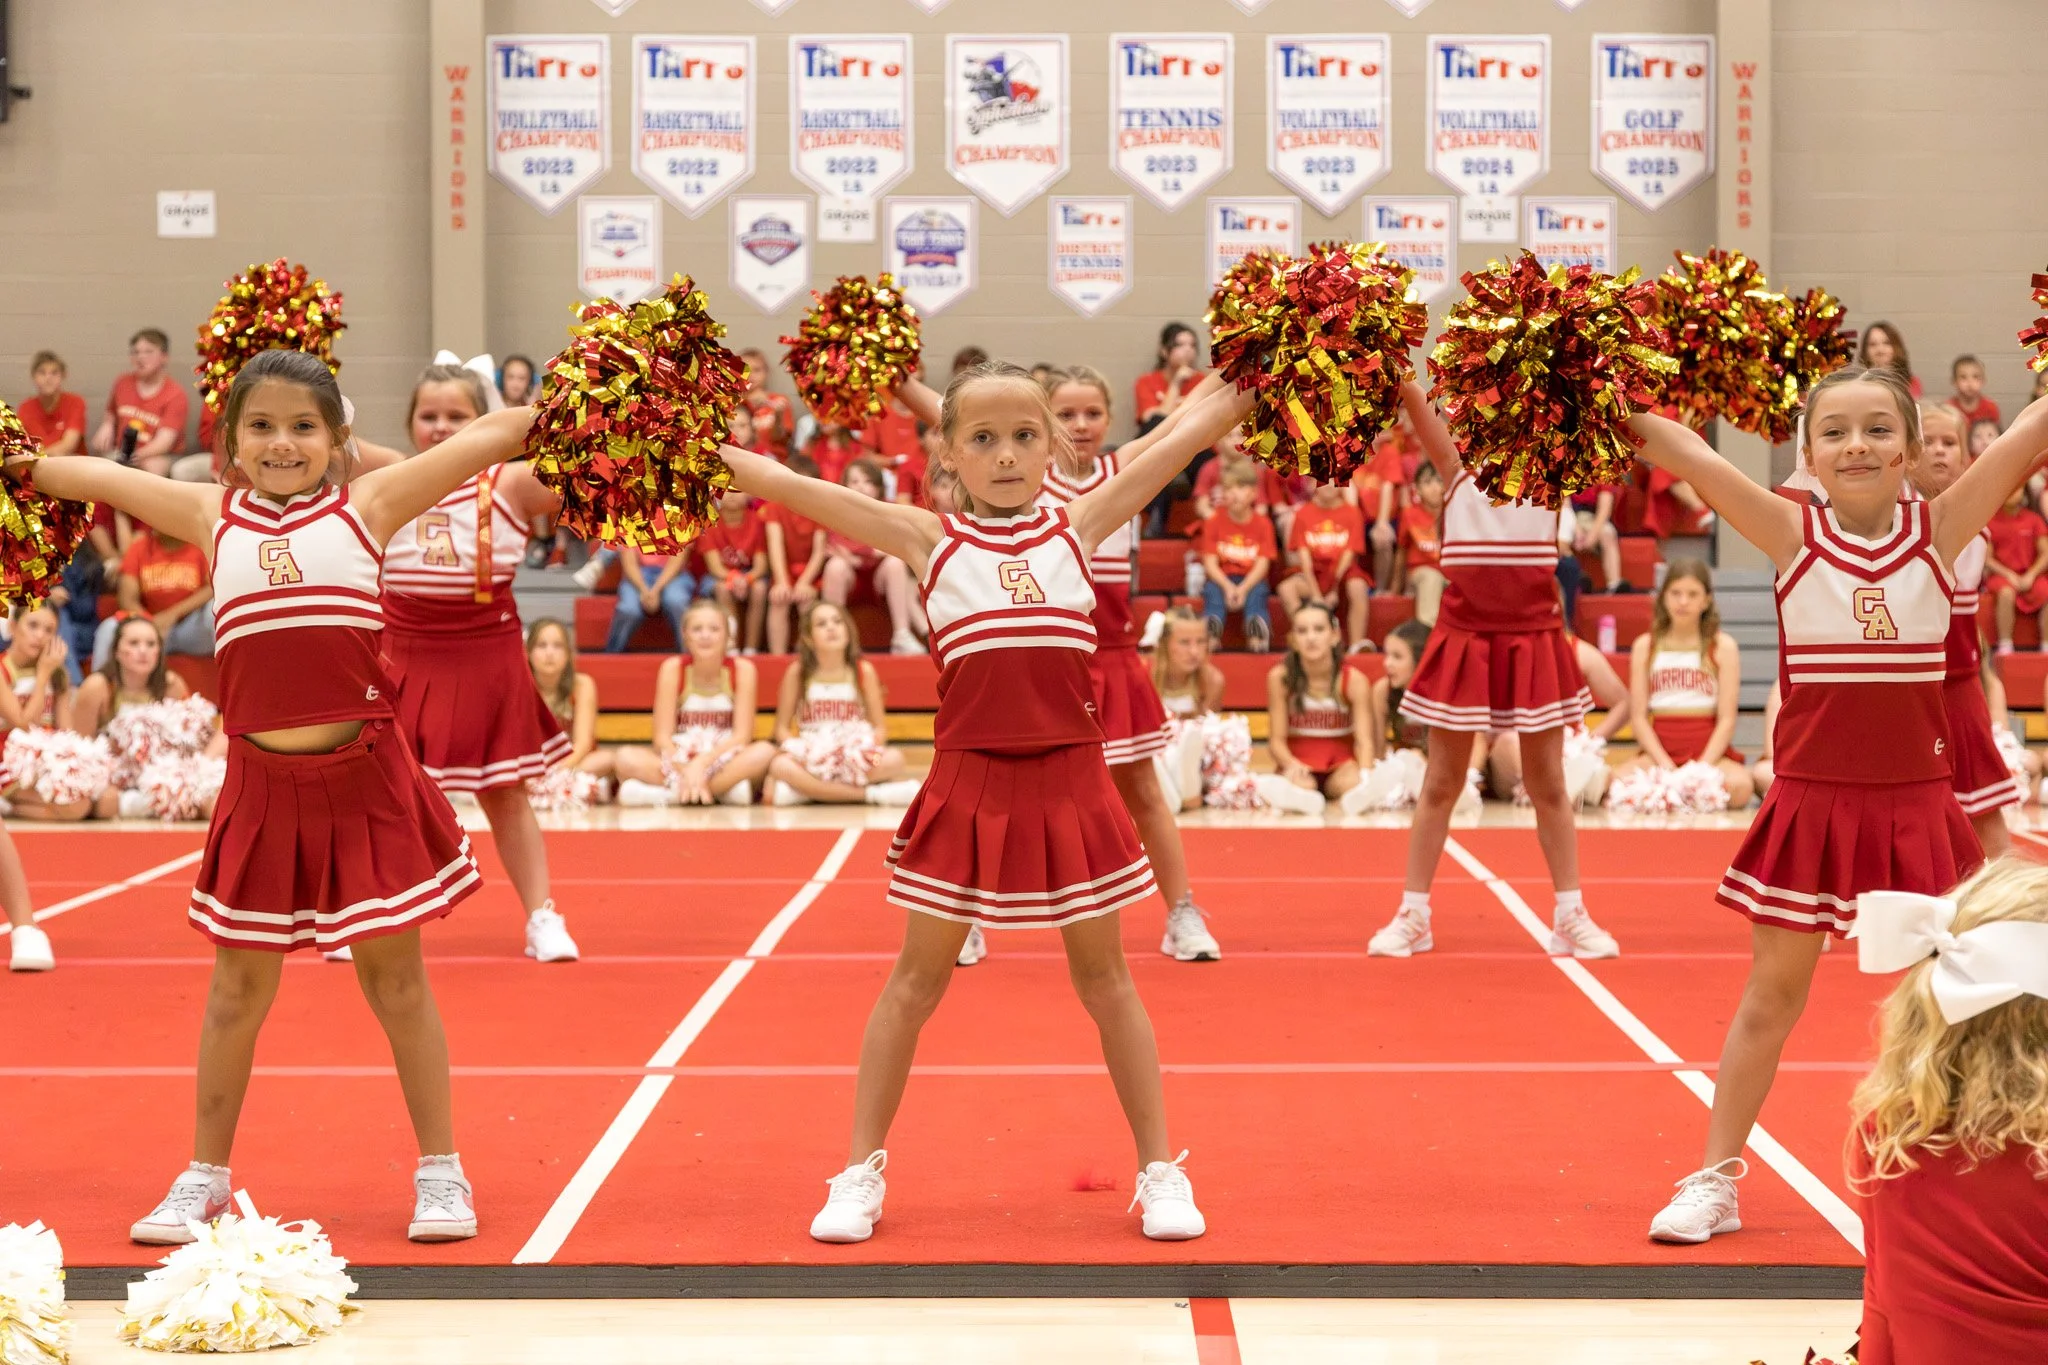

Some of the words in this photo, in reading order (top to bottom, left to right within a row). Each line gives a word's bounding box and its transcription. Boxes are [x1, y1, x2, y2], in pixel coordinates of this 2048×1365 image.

[497, 109, 598, 130] VOLLEYBALL
[1120, 108, 1223, 127] TENNIS
[1280, 109, 1378, 128] VOLLEYBALL
[1438, 109, 1537, 129] VOLLEYBALL
[1624, 109, 1684, 129] GOLF
[443, 64, 471, 231] WARRIORS
[497, 130, 600, 152] CHAMPION
[1119, 129, 1222, 150] CHAMPION
[1277, 129, 1380, 152] CHAMPION
[1437, 130, 1539, 152] CHAMPION
[1601, 130, 1705, 152] CHAMPION
[1731, 62, 1758, 229] WARRIORS
[826, 157, 877, 174] 2022
[955, 144, 1059, 166] CHAMPION
[1145, 155, 1197, 173] 2023
[1303, 157, 1356, 174] 2023
[523, 158, 575, 175] 2022
[667, 158, 719, 176] 2022
[1462, 158, 1514, 175] 2024
[1627, 158, 1679, 175] 2025
[258, 538, 303, 586] CA
[998, 559, 1046, 605] CA
[1852, 587, 1899, 641] CA
